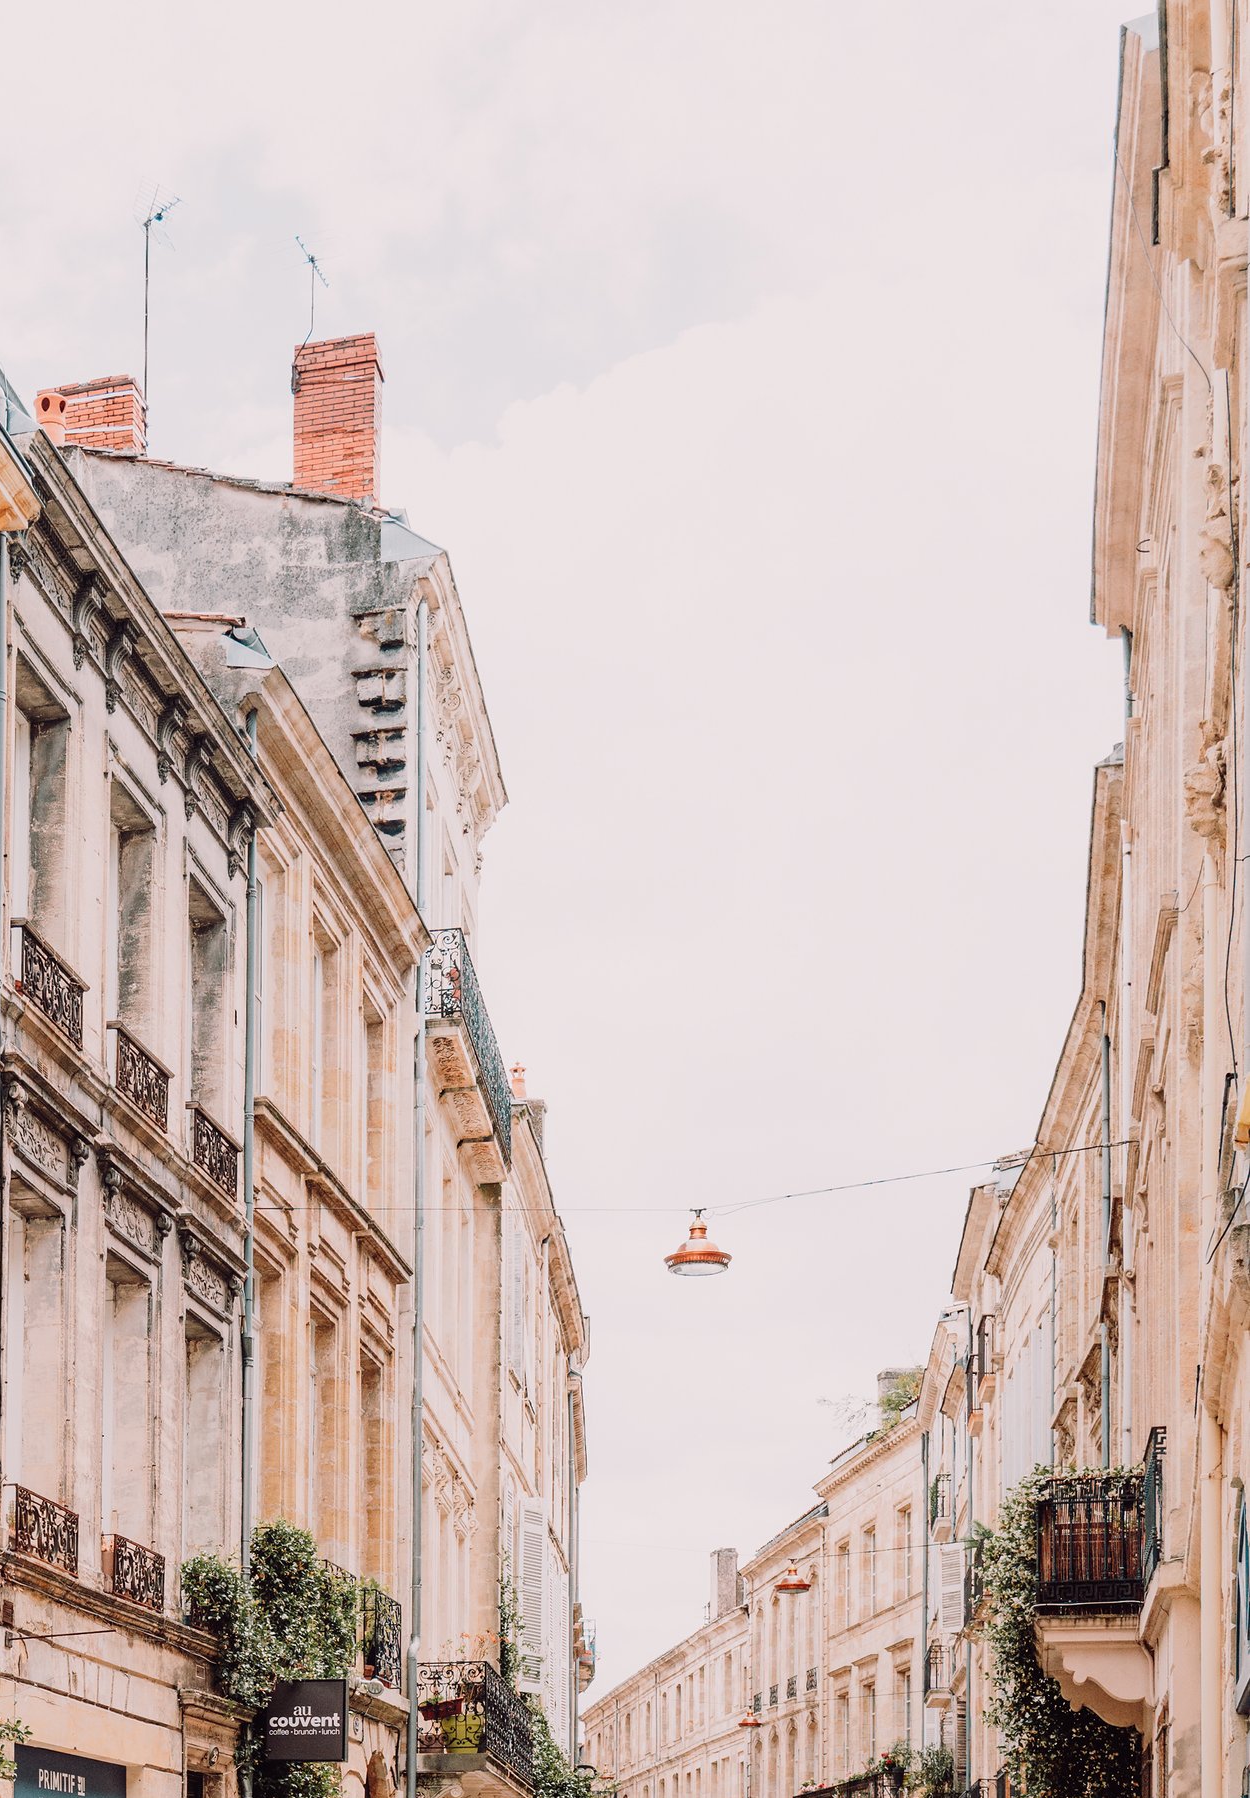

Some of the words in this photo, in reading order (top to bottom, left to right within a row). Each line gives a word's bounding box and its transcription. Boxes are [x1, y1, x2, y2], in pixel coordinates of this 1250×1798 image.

[293, 1705, 312, 1716] au
[269, 1712, 341, 1728] couvent
[38, 1768, 76, 1794] PRIMITIF
